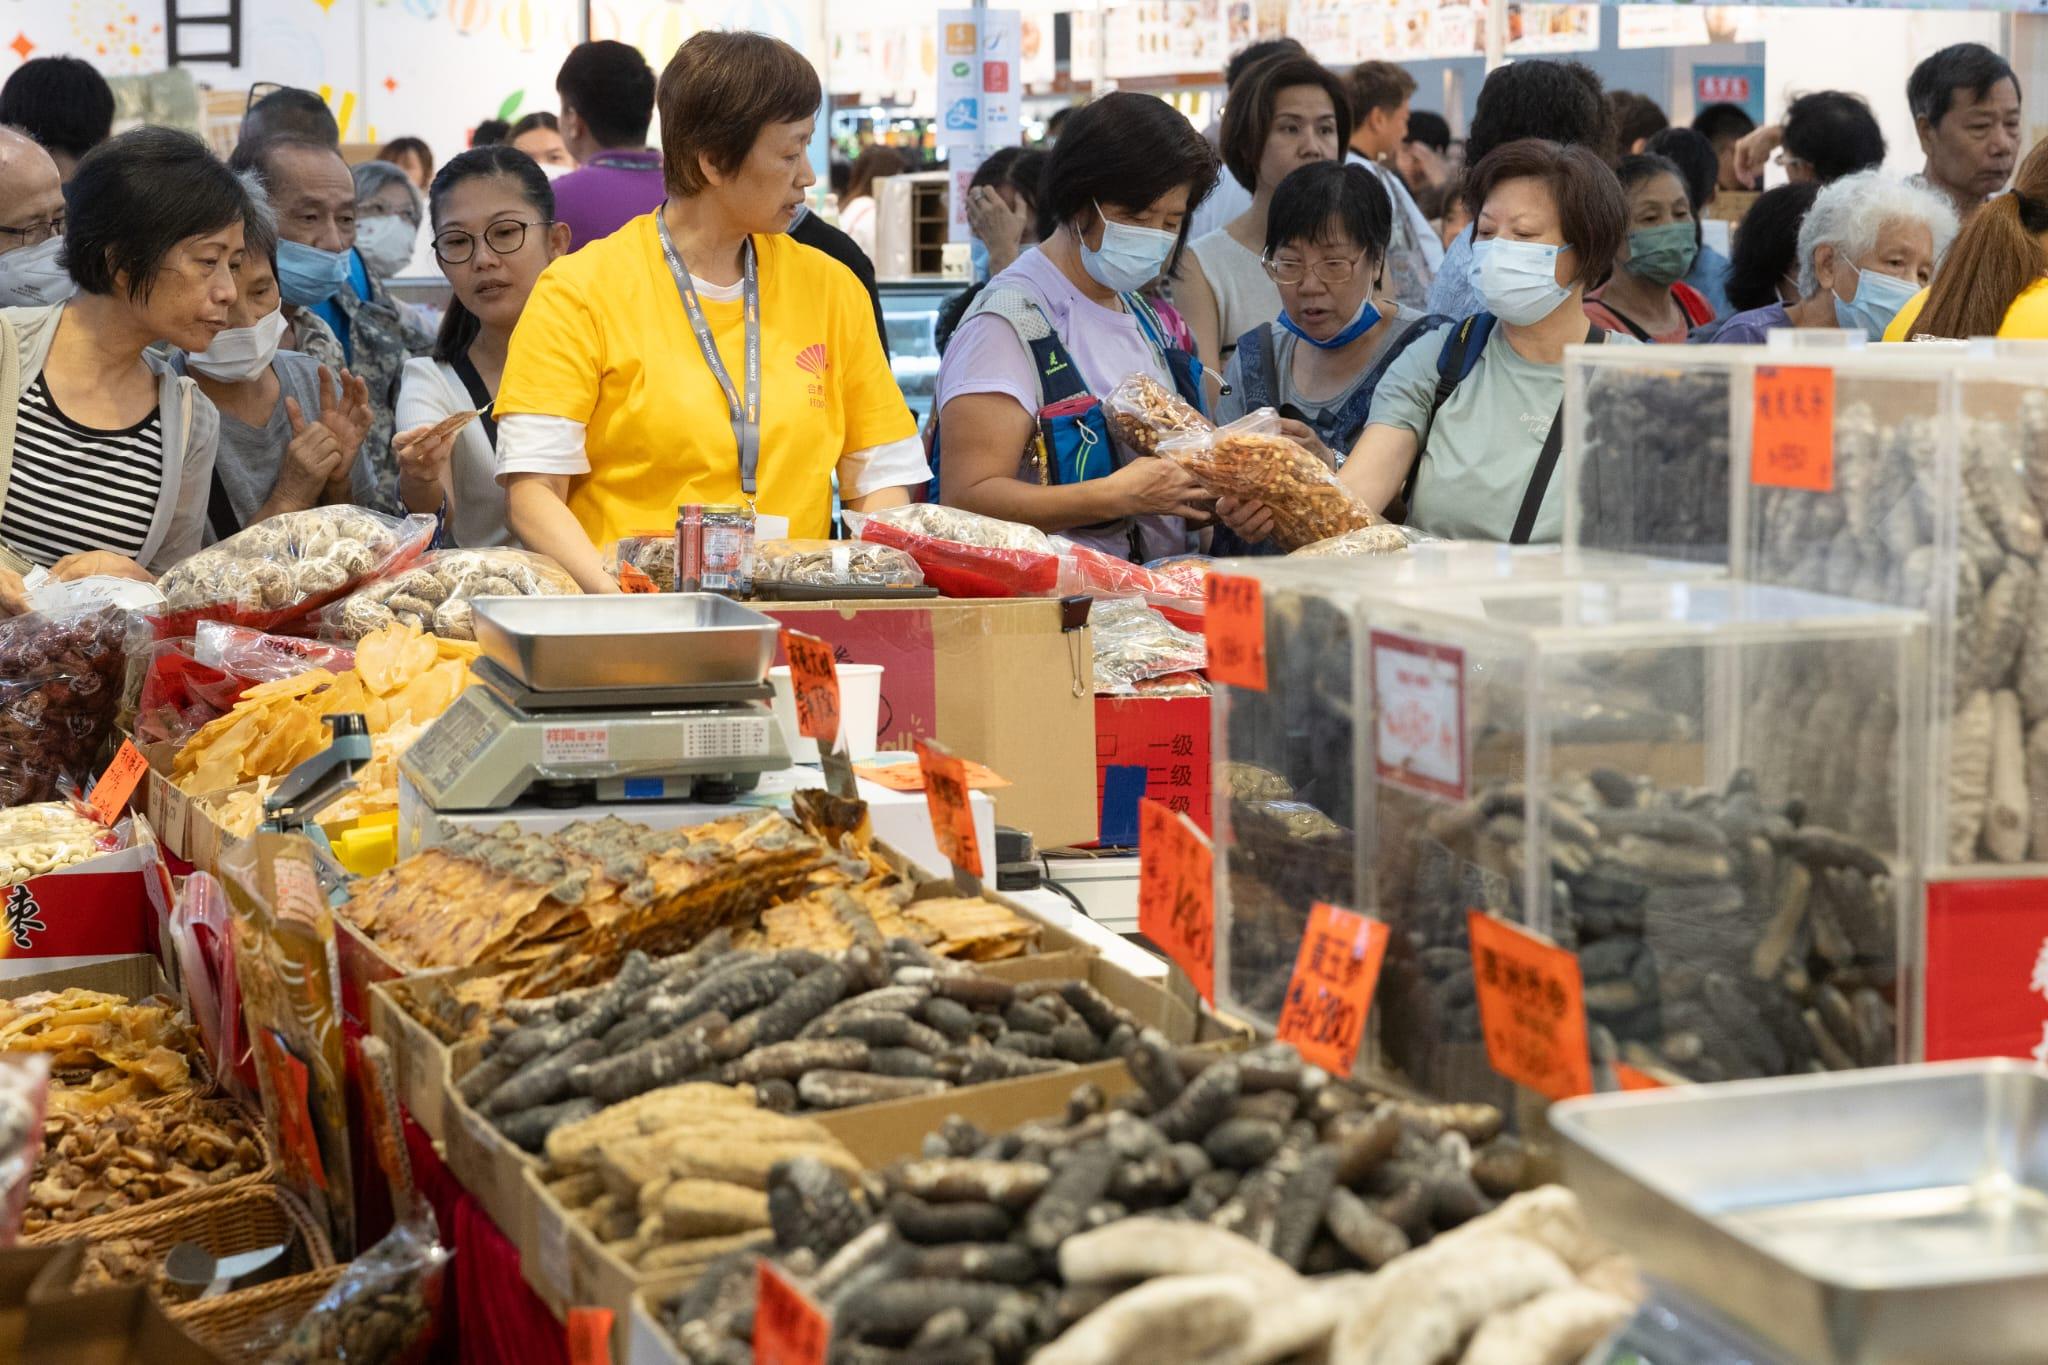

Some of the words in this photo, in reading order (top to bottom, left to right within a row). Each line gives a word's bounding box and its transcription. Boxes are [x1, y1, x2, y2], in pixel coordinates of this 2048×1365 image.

[1148, 734, 1193, 757] 一级
[1146, 764, 1192, 787] 二级
[1148, 795, 1191, 815] 级
